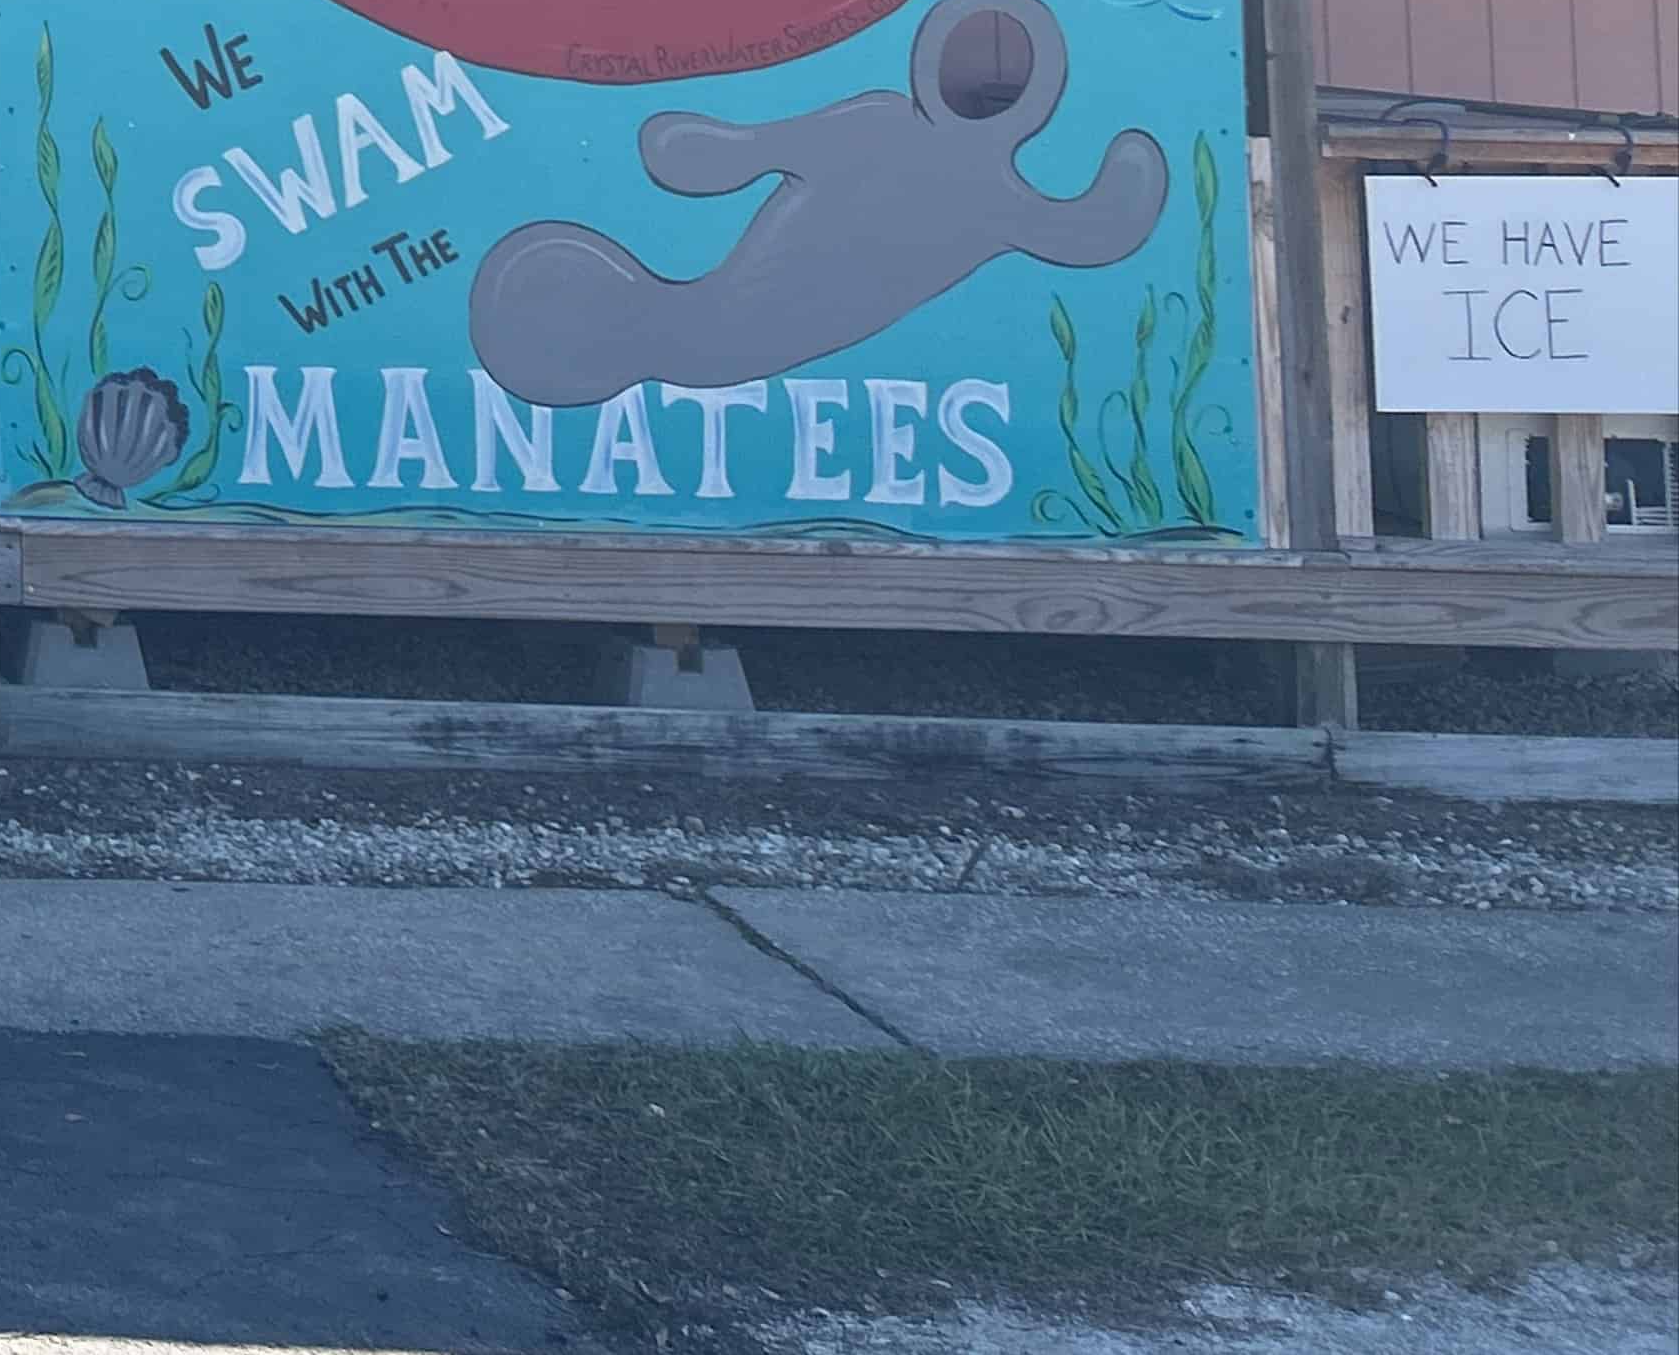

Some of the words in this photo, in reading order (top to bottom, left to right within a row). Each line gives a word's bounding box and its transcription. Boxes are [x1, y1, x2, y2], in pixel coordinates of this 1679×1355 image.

[159, 23, 264, 110] WE
[171, 49, 512, 272] SWAM
[277, 264, 386, 335] WITH
[371, 229, 460, 284] THE
[1383, 219, 1469, 266] WE
[1502, 218, 1631, 268] HAVE
[1442, 289, 1589, 362] ICE
[237, 365, 1015, 510] MANATEES
